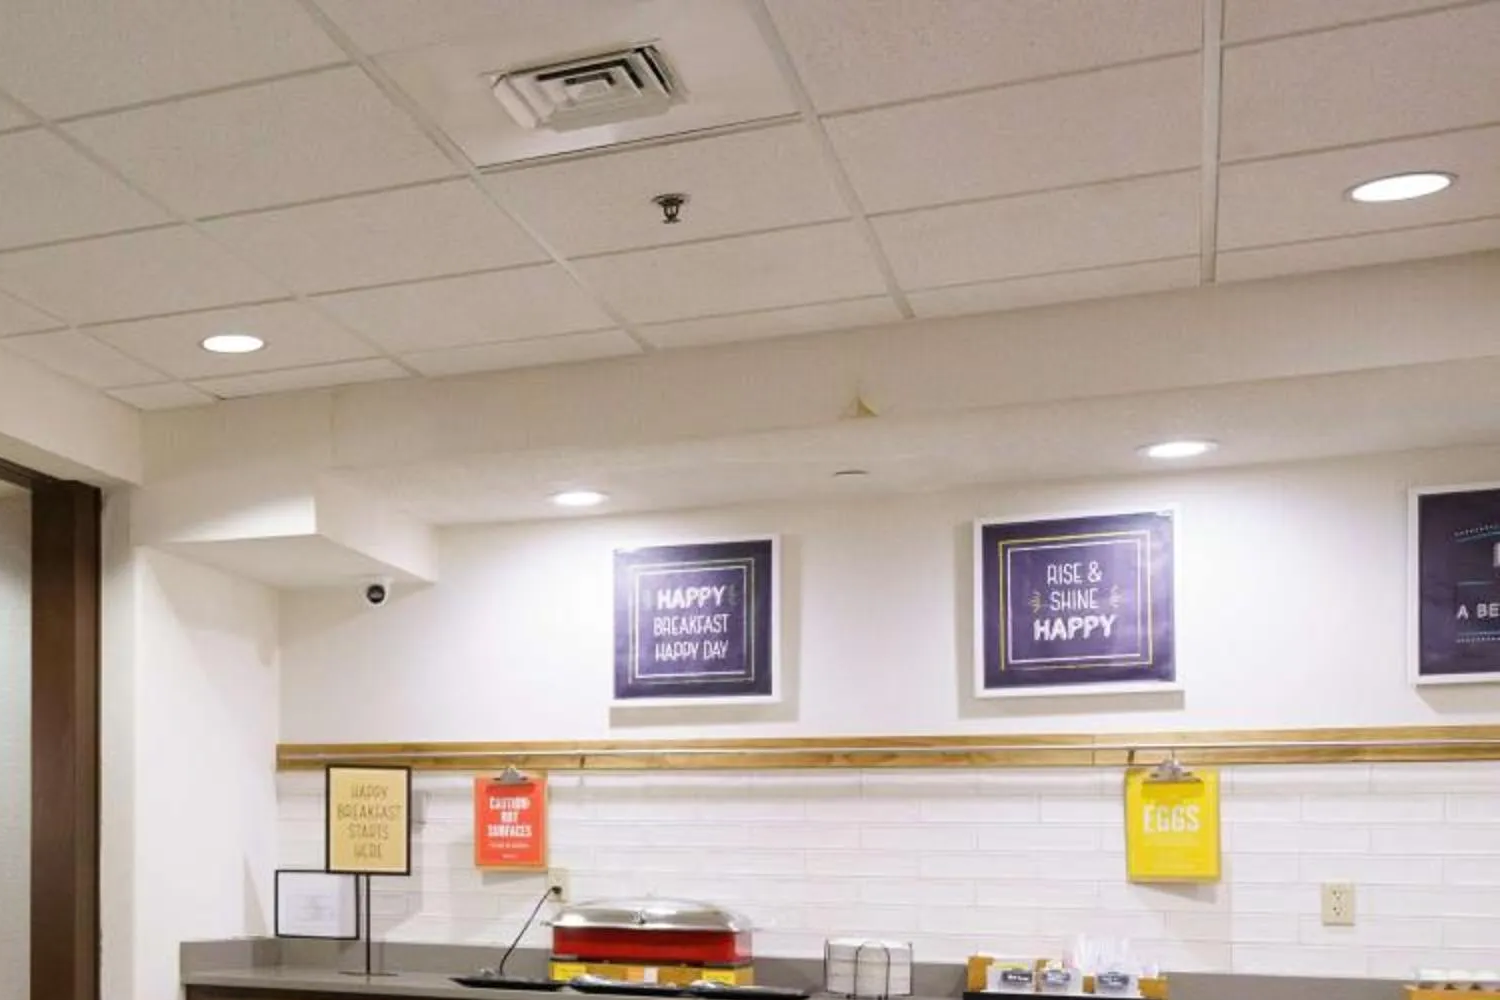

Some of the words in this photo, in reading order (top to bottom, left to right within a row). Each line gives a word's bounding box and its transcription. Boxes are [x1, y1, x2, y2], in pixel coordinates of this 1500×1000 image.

[1046, 563, 1082, 586] RISE
[1088, 560, 1102, 583] &
[657, 584, 726, 610] HAPPY
[1050, 588, 1100, 612] SHINE
[1457, 604, 1469, 619] A
[653, 613, 731, 637] BREAKFAST
[1033, 614, 1117, 641] HAPPY
[655, 641, 699, 662] HAPPY
[703, 639, 729, 660] DAY
[1143, 803, 1201, 834] EGGS
